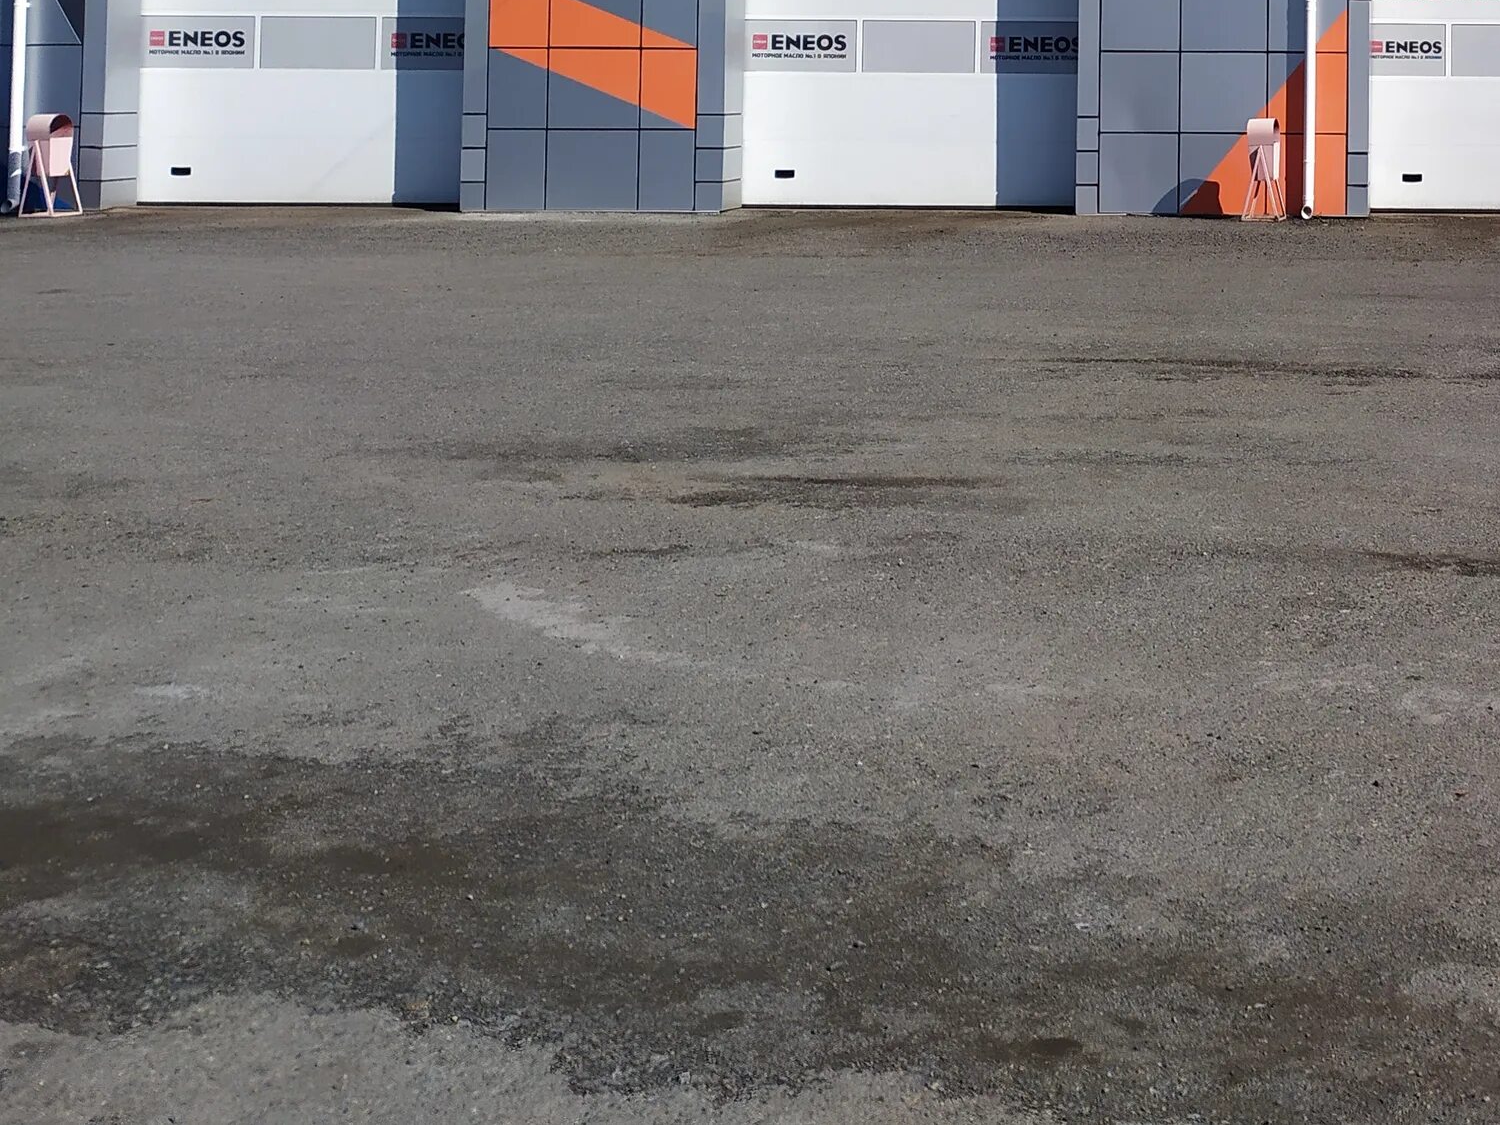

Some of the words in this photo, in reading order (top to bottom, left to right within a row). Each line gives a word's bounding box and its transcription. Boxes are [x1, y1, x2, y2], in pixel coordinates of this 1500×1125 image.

[168, 30, 245, 48] ENEOS
[771, 34, 847, 51] ENEOS
[1385, 40, 1442, 54] ENEOS
